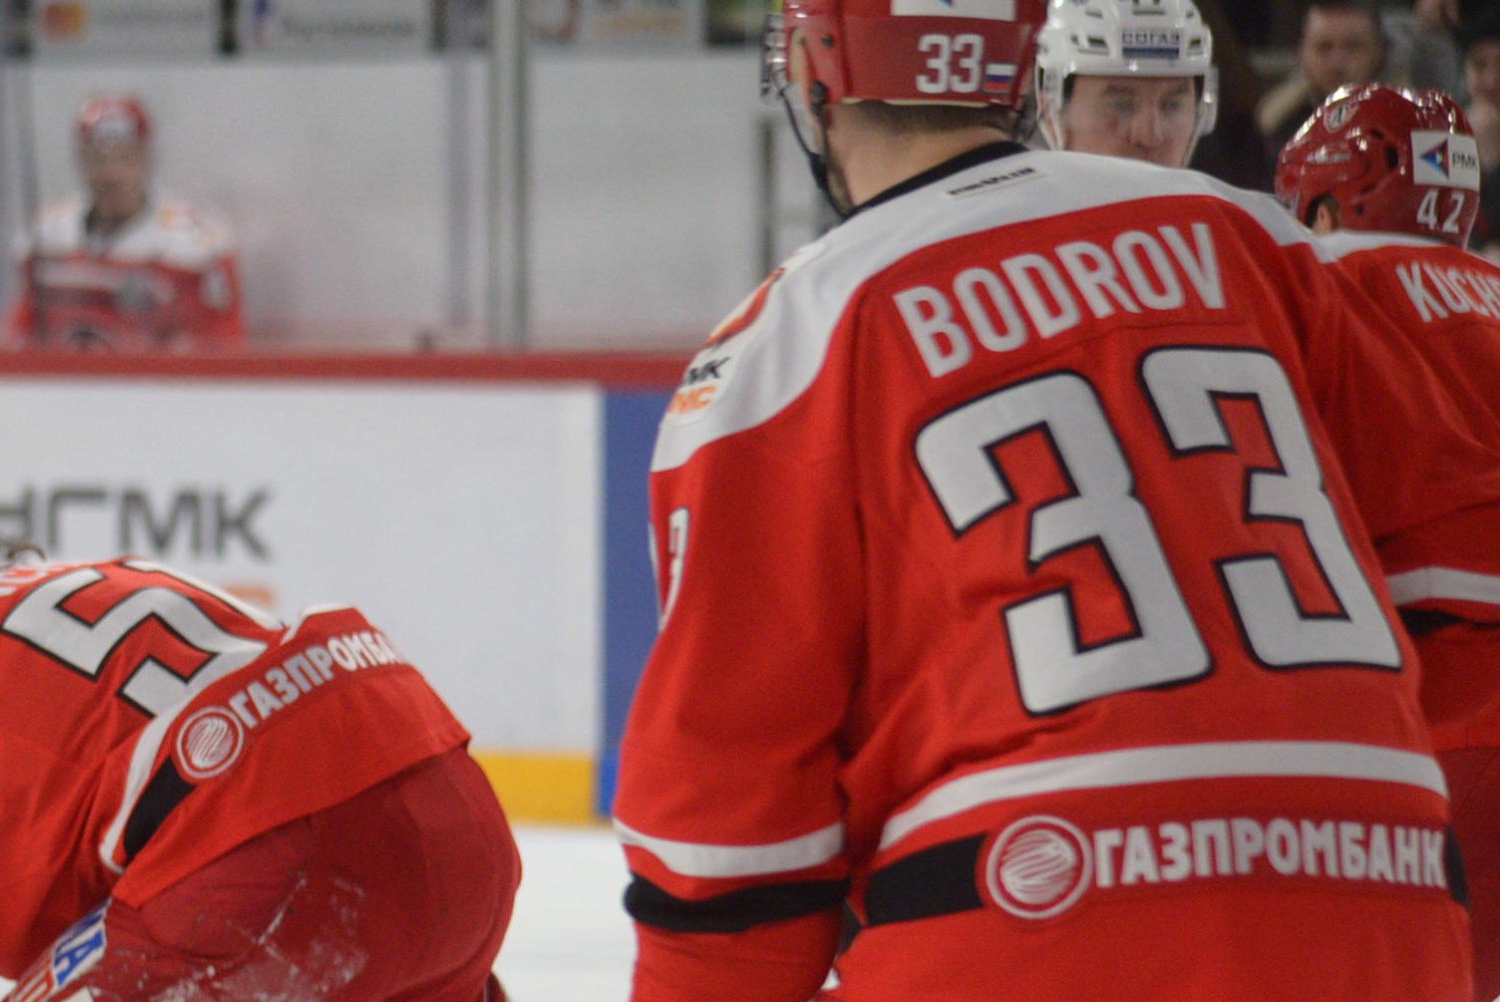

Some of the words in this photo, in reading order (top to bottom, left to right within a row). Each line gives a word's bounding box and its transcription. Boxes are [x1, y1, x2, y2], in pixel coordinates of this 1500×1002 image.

[915, 33, 985, 94] 33
[1122, 29, 1180, 46] СОГАЗ
[1415, 188, 1466, 234] 42
[892, 222, 1226, 379] BODROV
[915, 343, 1403, 718] 33
[229, 630, 399, 729] ГАЗПРОМБА
[1092, 817, 1448, 890] ГАЗПРОМБАНК
